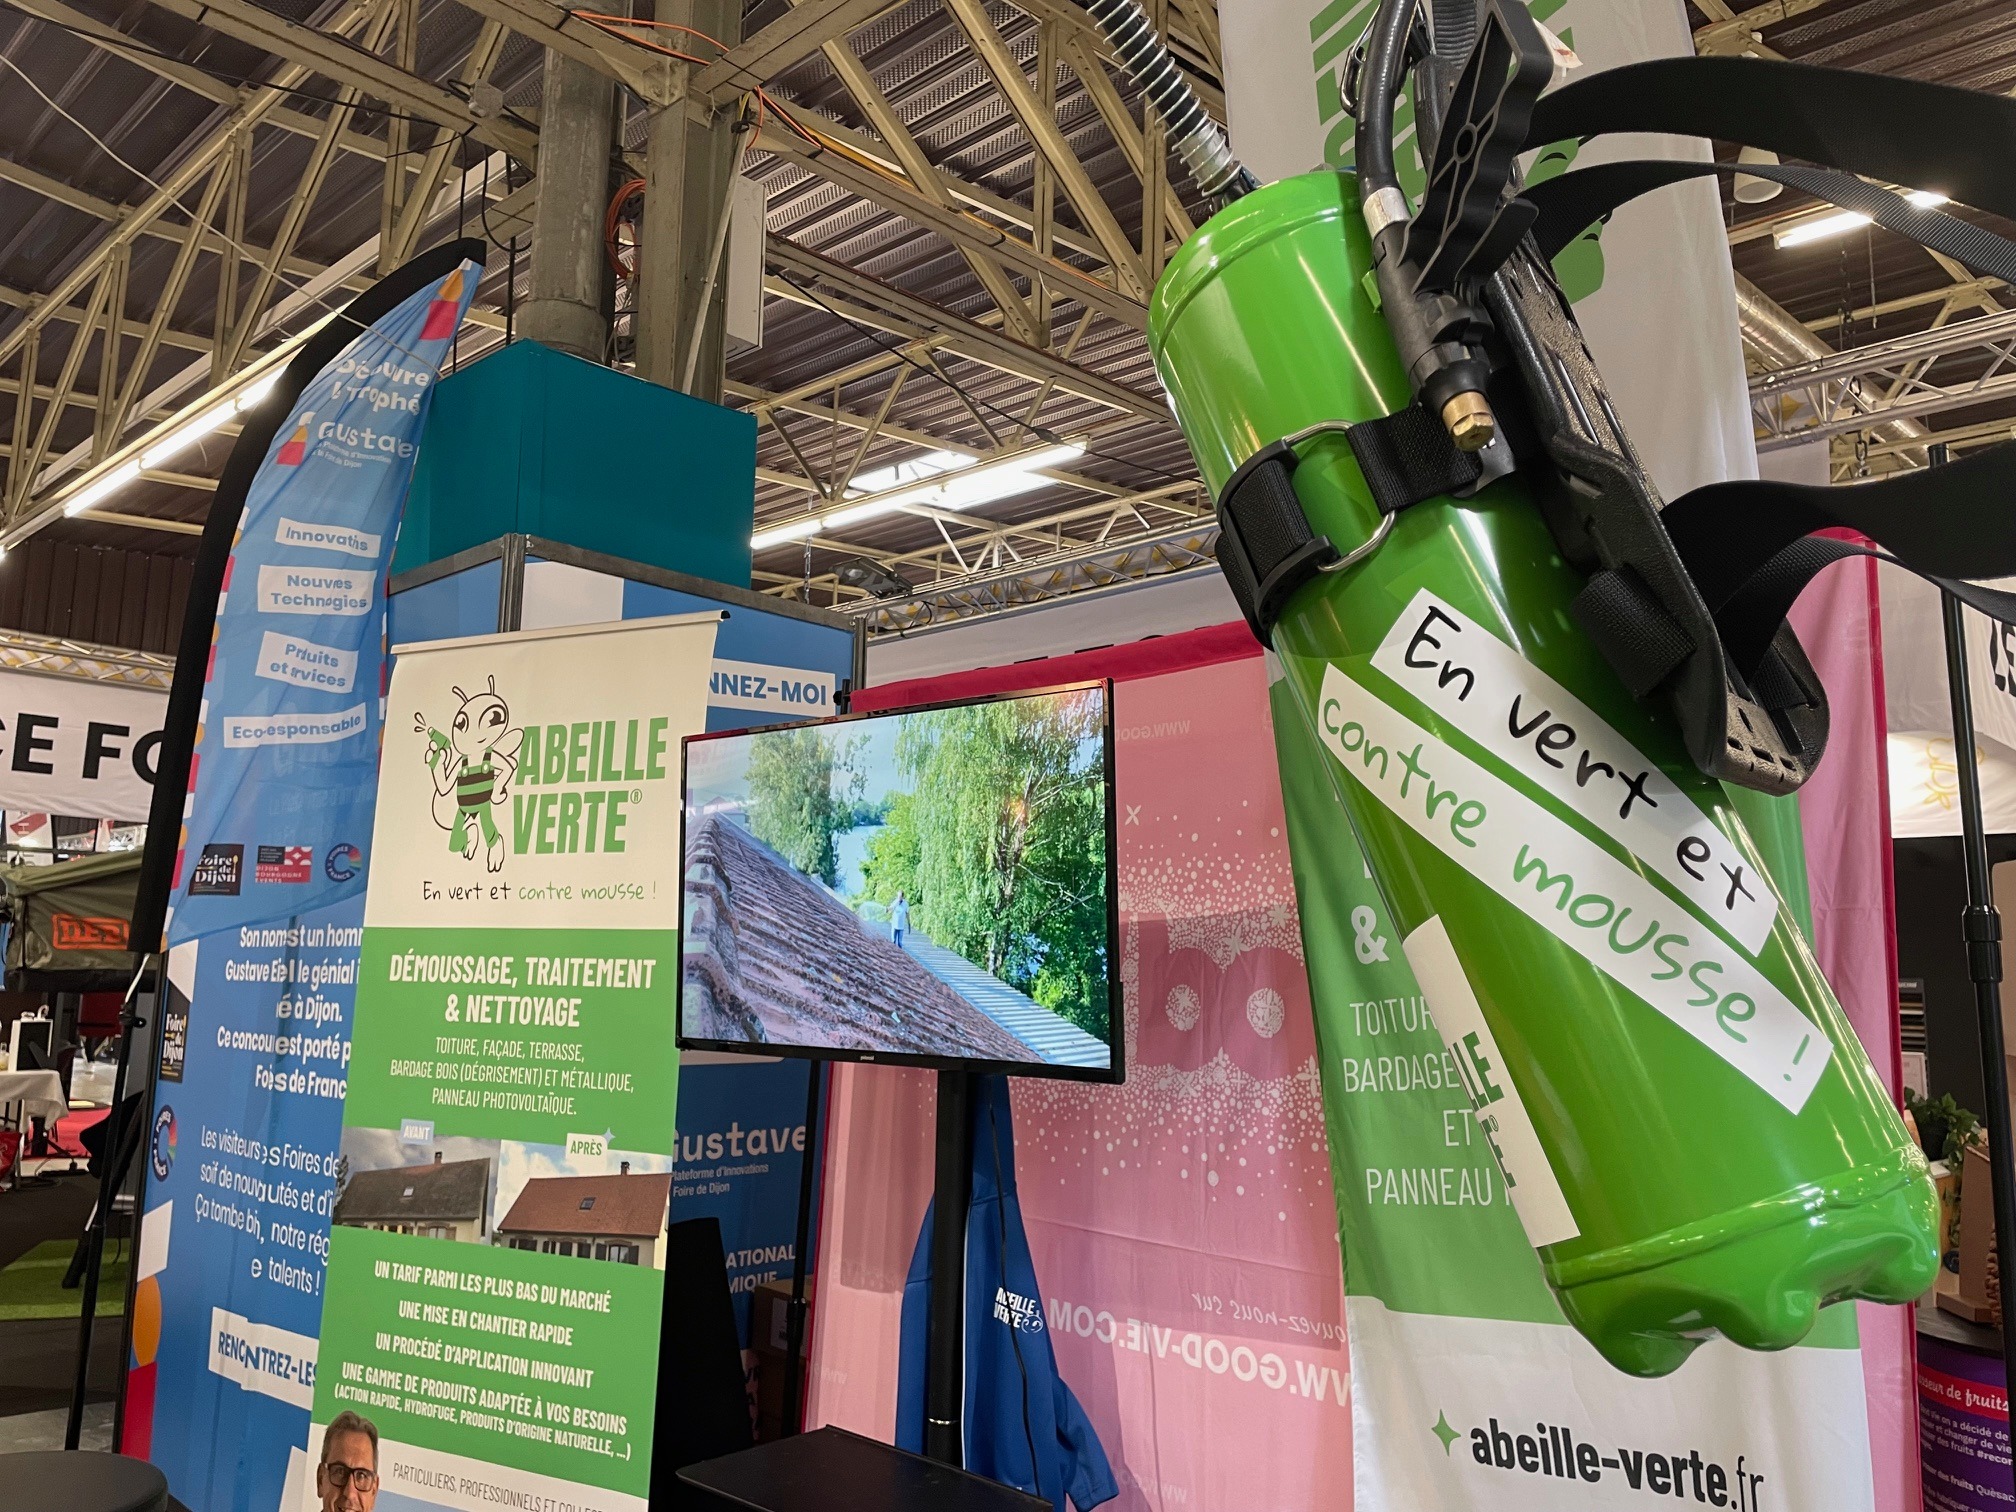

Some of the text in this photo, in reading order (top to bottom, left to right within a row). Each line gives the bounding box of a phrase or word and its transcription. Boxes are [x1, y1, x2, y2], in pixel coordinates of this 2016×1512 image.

[318, 421, 414, 459] Gustae
[514, 716, 669, 786] ABEILLE
[1403, 604, 1756, 911] En vert et
[195, 870, 237, 886] Dijon
[423, 880, 441, 901] En
[448, 881, 484, 901] vert
[489, 881, 512, 900] et
[518, 880, 573, 901] contre
[580, 882, 645, 901] mousse
[1322, 698, 1812, 1083] contre mousse !
[240, 926, 260, 948] Son
[307, 928, 325, 948] un
[1350, 904, 1390, 965] &
[225, 959, 270, 982] Gustave
[297, 959, 310, 984] le
[310, 957, 355, 992] génial
[389, 948, 657, 989] DÉMOUSSAGE, TRAITEMENT
[294, 992, 304, 1020] à
[305, 994, 343, 1030] Dijon.
[445, 993, 582, 1028] & NETTOYAGE
[217, 1025, 232, 1048] Ce
[303, 1032, 341, 1066] porté
[435, 1036, 585, 1064] TOITURE, FAÇADE, TERRASSE,
[288, 1068, 306, 1095] de
[390, 1059, 635, 1094] BARDAGE BOIS (DÉGRISEMENT) ET MÉTALLIQUE,
[1343, 1052, 1460, 1093] BARDAGE
[431, 1087, 577, 1116] PANNEAU PHOTOVOLTAÏQUE.
[403, 1124, 431, 1140] AVANT
[1443, 1108, 1473, 1147] ET
[201, 1124, 218, 1150] Les
[219, 1127, 261, 1161] visiteurs
[282, 1142, 321, 1175] Foires
[570, 1139, 603, 1157] APRÈS
[200, 1160, 219, 1185] soif
[219, 1164, 233, 1190] de
[301, 1188, 315, 1214] et
[672, 1182, 731, 1198] Foire de Dijon
[1365, 1167, 1493, 1207] PANNEAU
[195, 1192, 210, 1223] Ça
[210, 1197, 245, 1231] tombe
[271, 1222, 306, 1251] notre
[268, 1256, 313, 1295] talents
[374, 1259, 612, 1314] UN TARIF PARMI LES PLUS BAS DU MARCHÉ
[398, 1299, 574, 1347] UNE MISE EN CHANTIER RAPIDE
[375, 1331, 594, 1389] UN PROCÉDÉ D'APPLICATION INNOVANT
[341, 1361, 628, 1437] UNE GAMME DE PRODUITS ADAPTÉE À VOS BESOINS
[1946, 1384, 1963, 1401] de
[334, 1382, 370, 1405] (ACTION
[369, 1390, 402, 1413] RAPIDE,
[404, 1398, 458, 1425] HYDROFUGE,
[460, 1409, 506, 1433] PRODUITS
[506, 1418, 553, 1444] D'ORIGINE
[554, 1428, 614, 1459] NATURELLE,
[1995, 1430, 2010, 1442] de
[1944, 1428, 1978, 1446] changer
[1980, 1439, 1993, 1450] de
[1996, 1443, 2013, 1455] vie
[1951, 1441, 1975, 1457] fruits
[1470, 1417, 1765, 1512] abeille-verte.fr
[1951, 1475, 1974, 1492] fruits
[393, 1462, 458, 1495] PARTICULIERS,
[459, 1477, 542, 1512] PROFESSIONNELS
